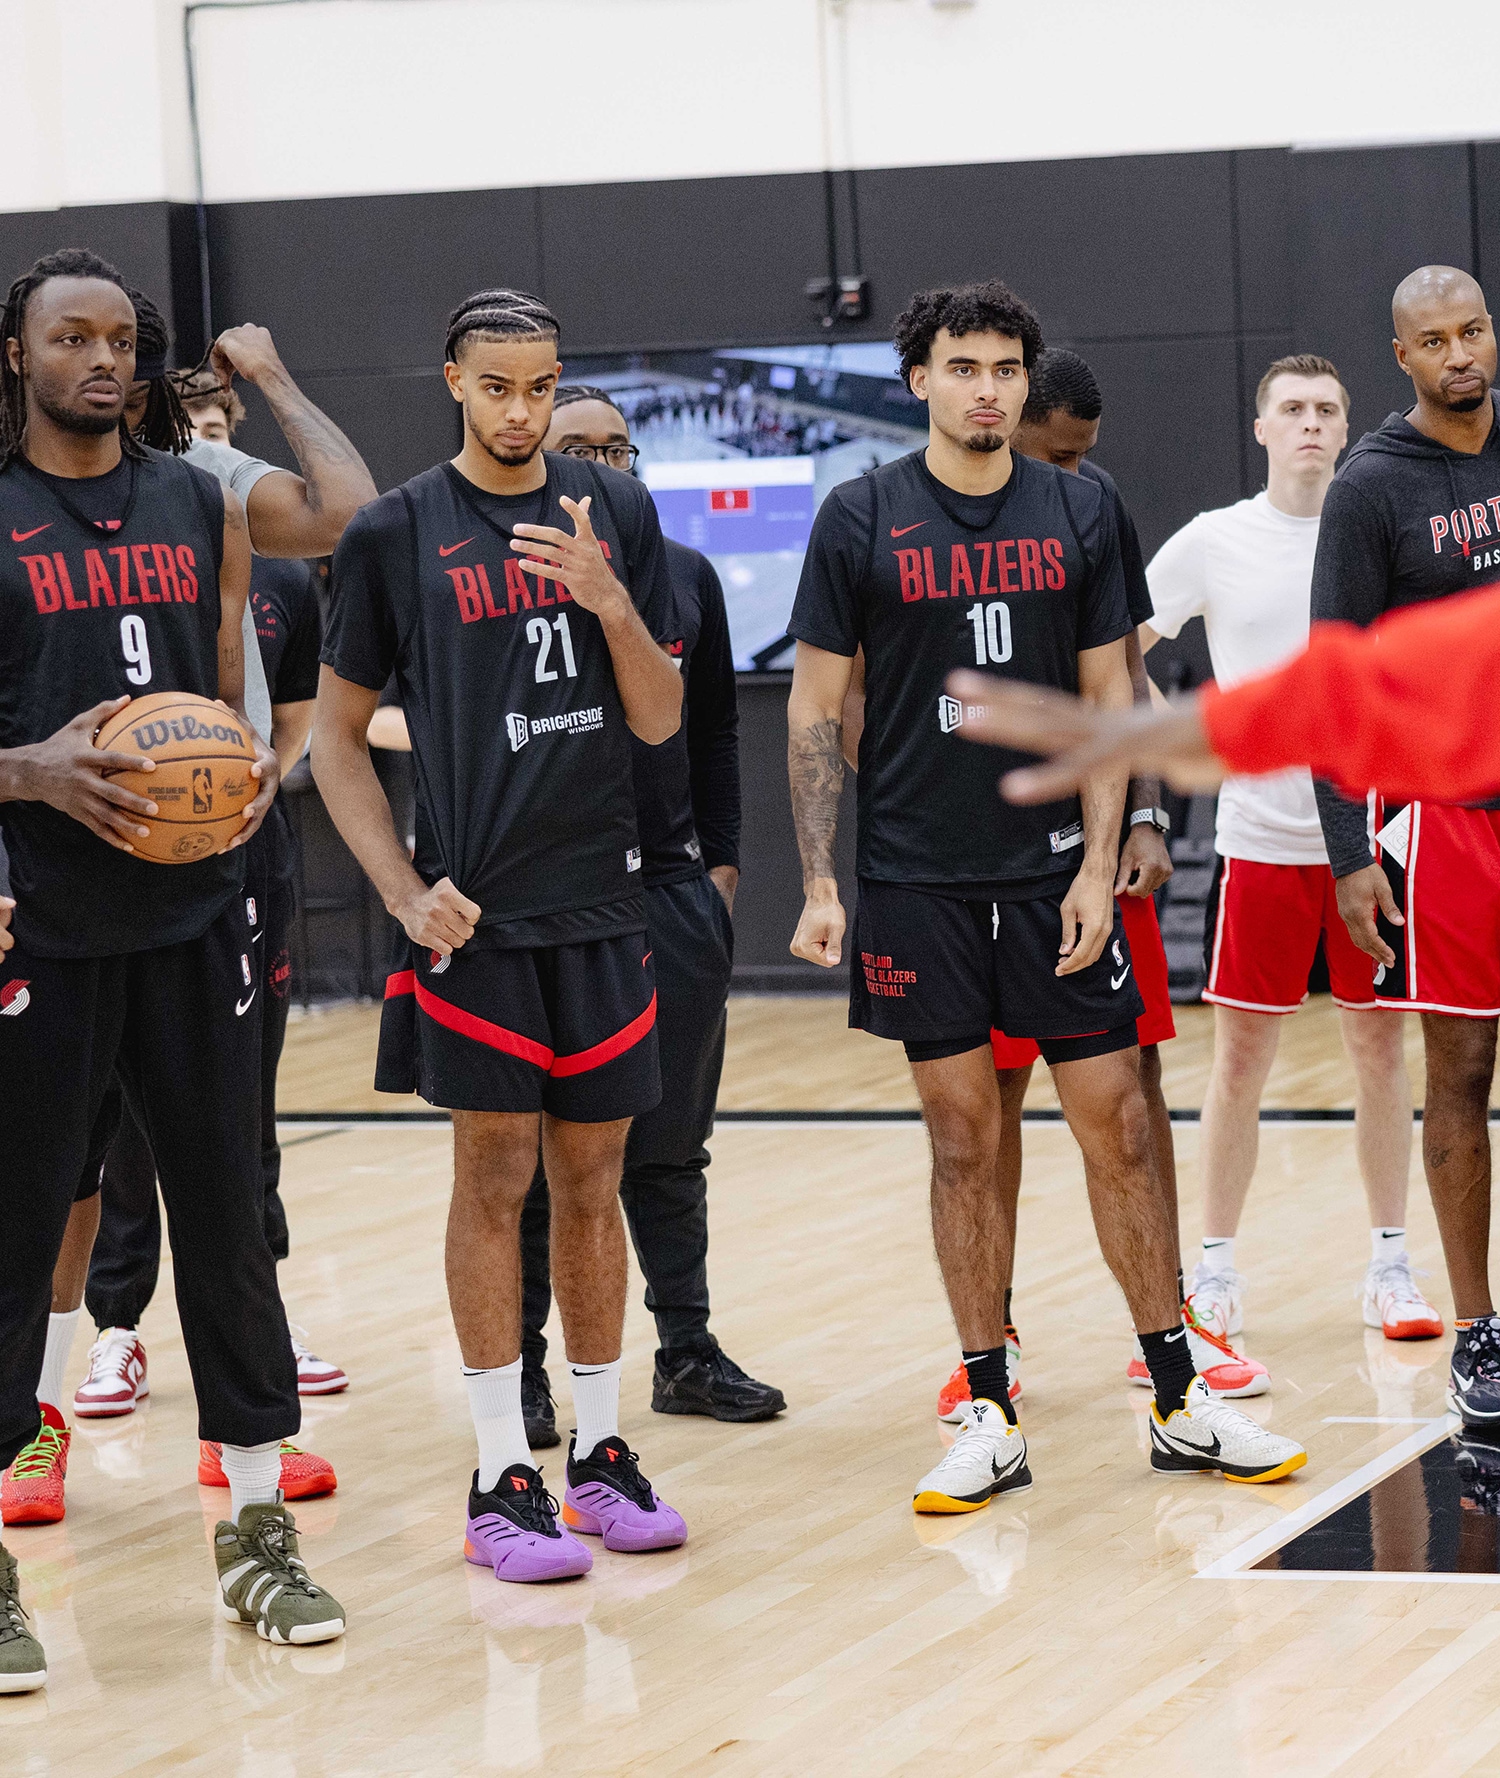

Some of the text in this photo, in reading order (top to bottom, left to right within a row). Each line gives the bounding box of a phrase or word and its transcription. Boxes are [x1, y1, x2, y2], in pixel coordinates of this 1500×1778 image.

[18, 543, 199, 615] BLAZERS
[444, 540, 615, 624] BLAZ
[892, 538, 1066, 603] BLAZERS
[120, 614, 152, 685] 9
[525, 612, 578, 683] 21
[966, 601, 1013, 665] 10
[132, 715, 246, 751] Wilson
[530, 706, 603, 735] BRIGHTSIDE
[568, 721, 604, 735] WINDOWS
[877, 969, 917, 984] BLAZERS
